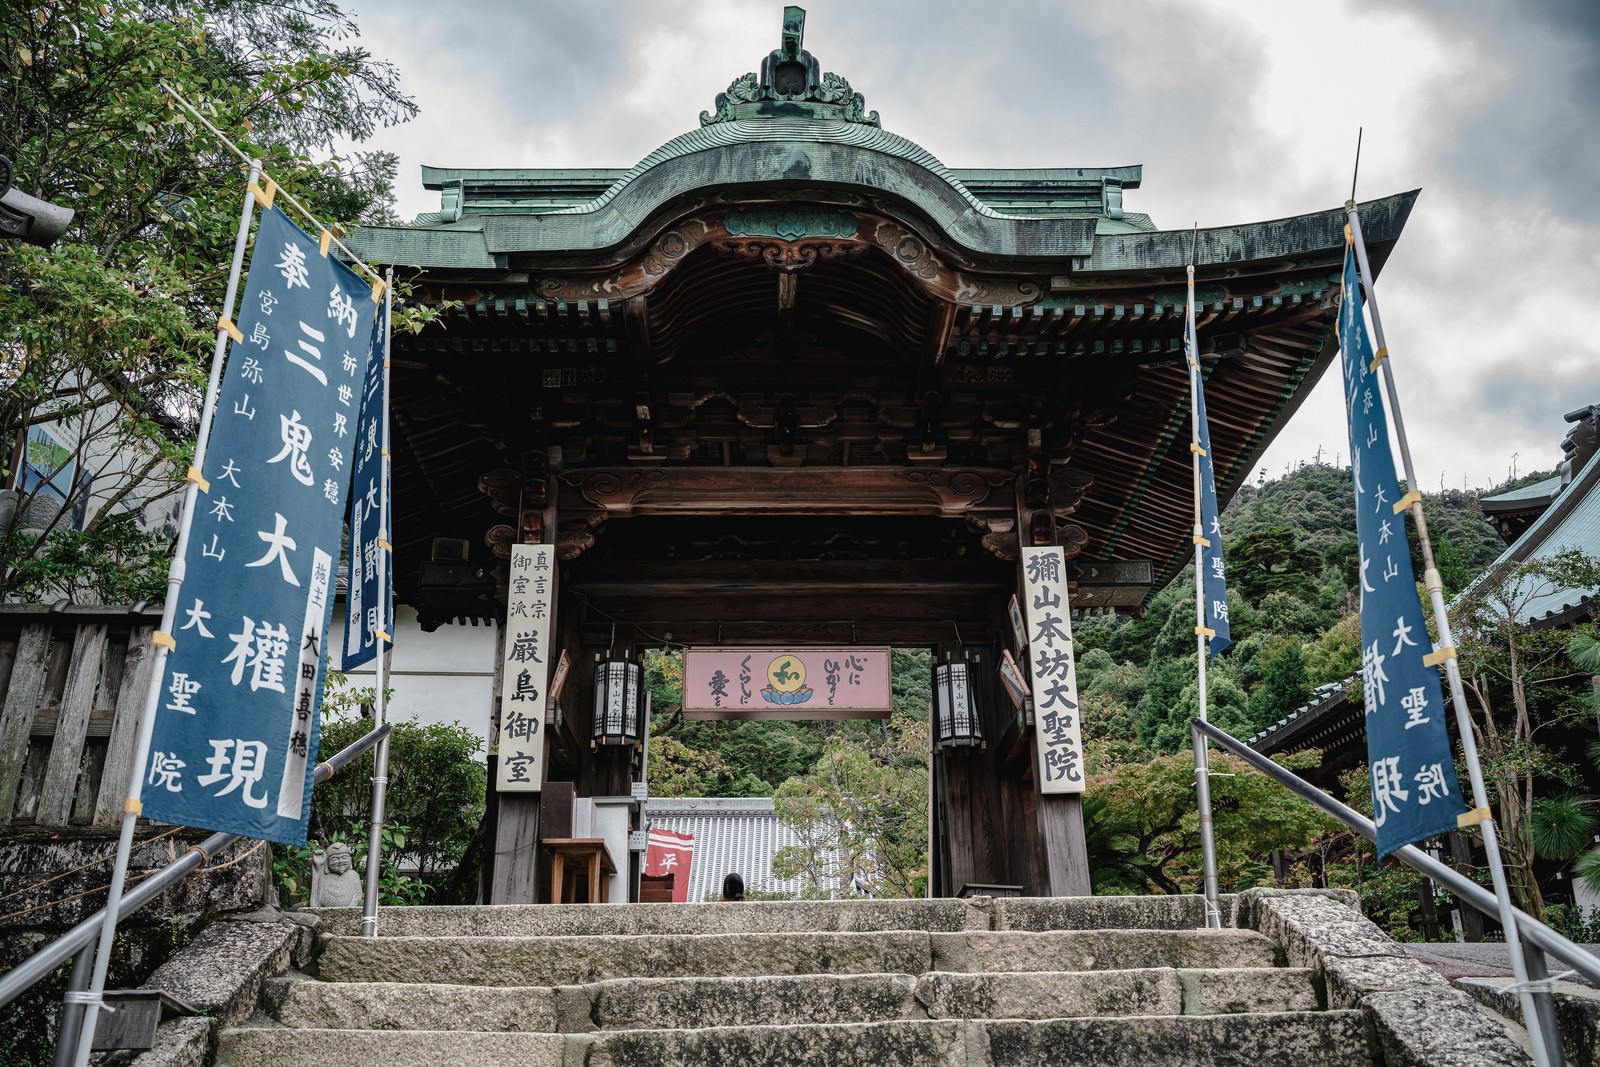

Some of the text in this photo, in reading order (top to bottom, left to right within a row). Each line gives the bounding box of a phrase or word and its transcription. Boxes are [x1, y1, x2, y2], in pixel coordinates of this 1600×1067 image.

[274, 241, 358, 338] 奉 納
[148, 290, 278, 793] 宮島弥山 大本山 大聖院
[510, 553, 531, 618] 御室派
[531, 551, 549, 619] 真言宗
[773, 661, 800, 685] 和
[844, 655, 868, 686] 心に
[1025, 552, 1082, 782] 彌山本坊大聖院
[504, 630, 542, 783] 厳島御室
[659, 853, 679, 871] 平
